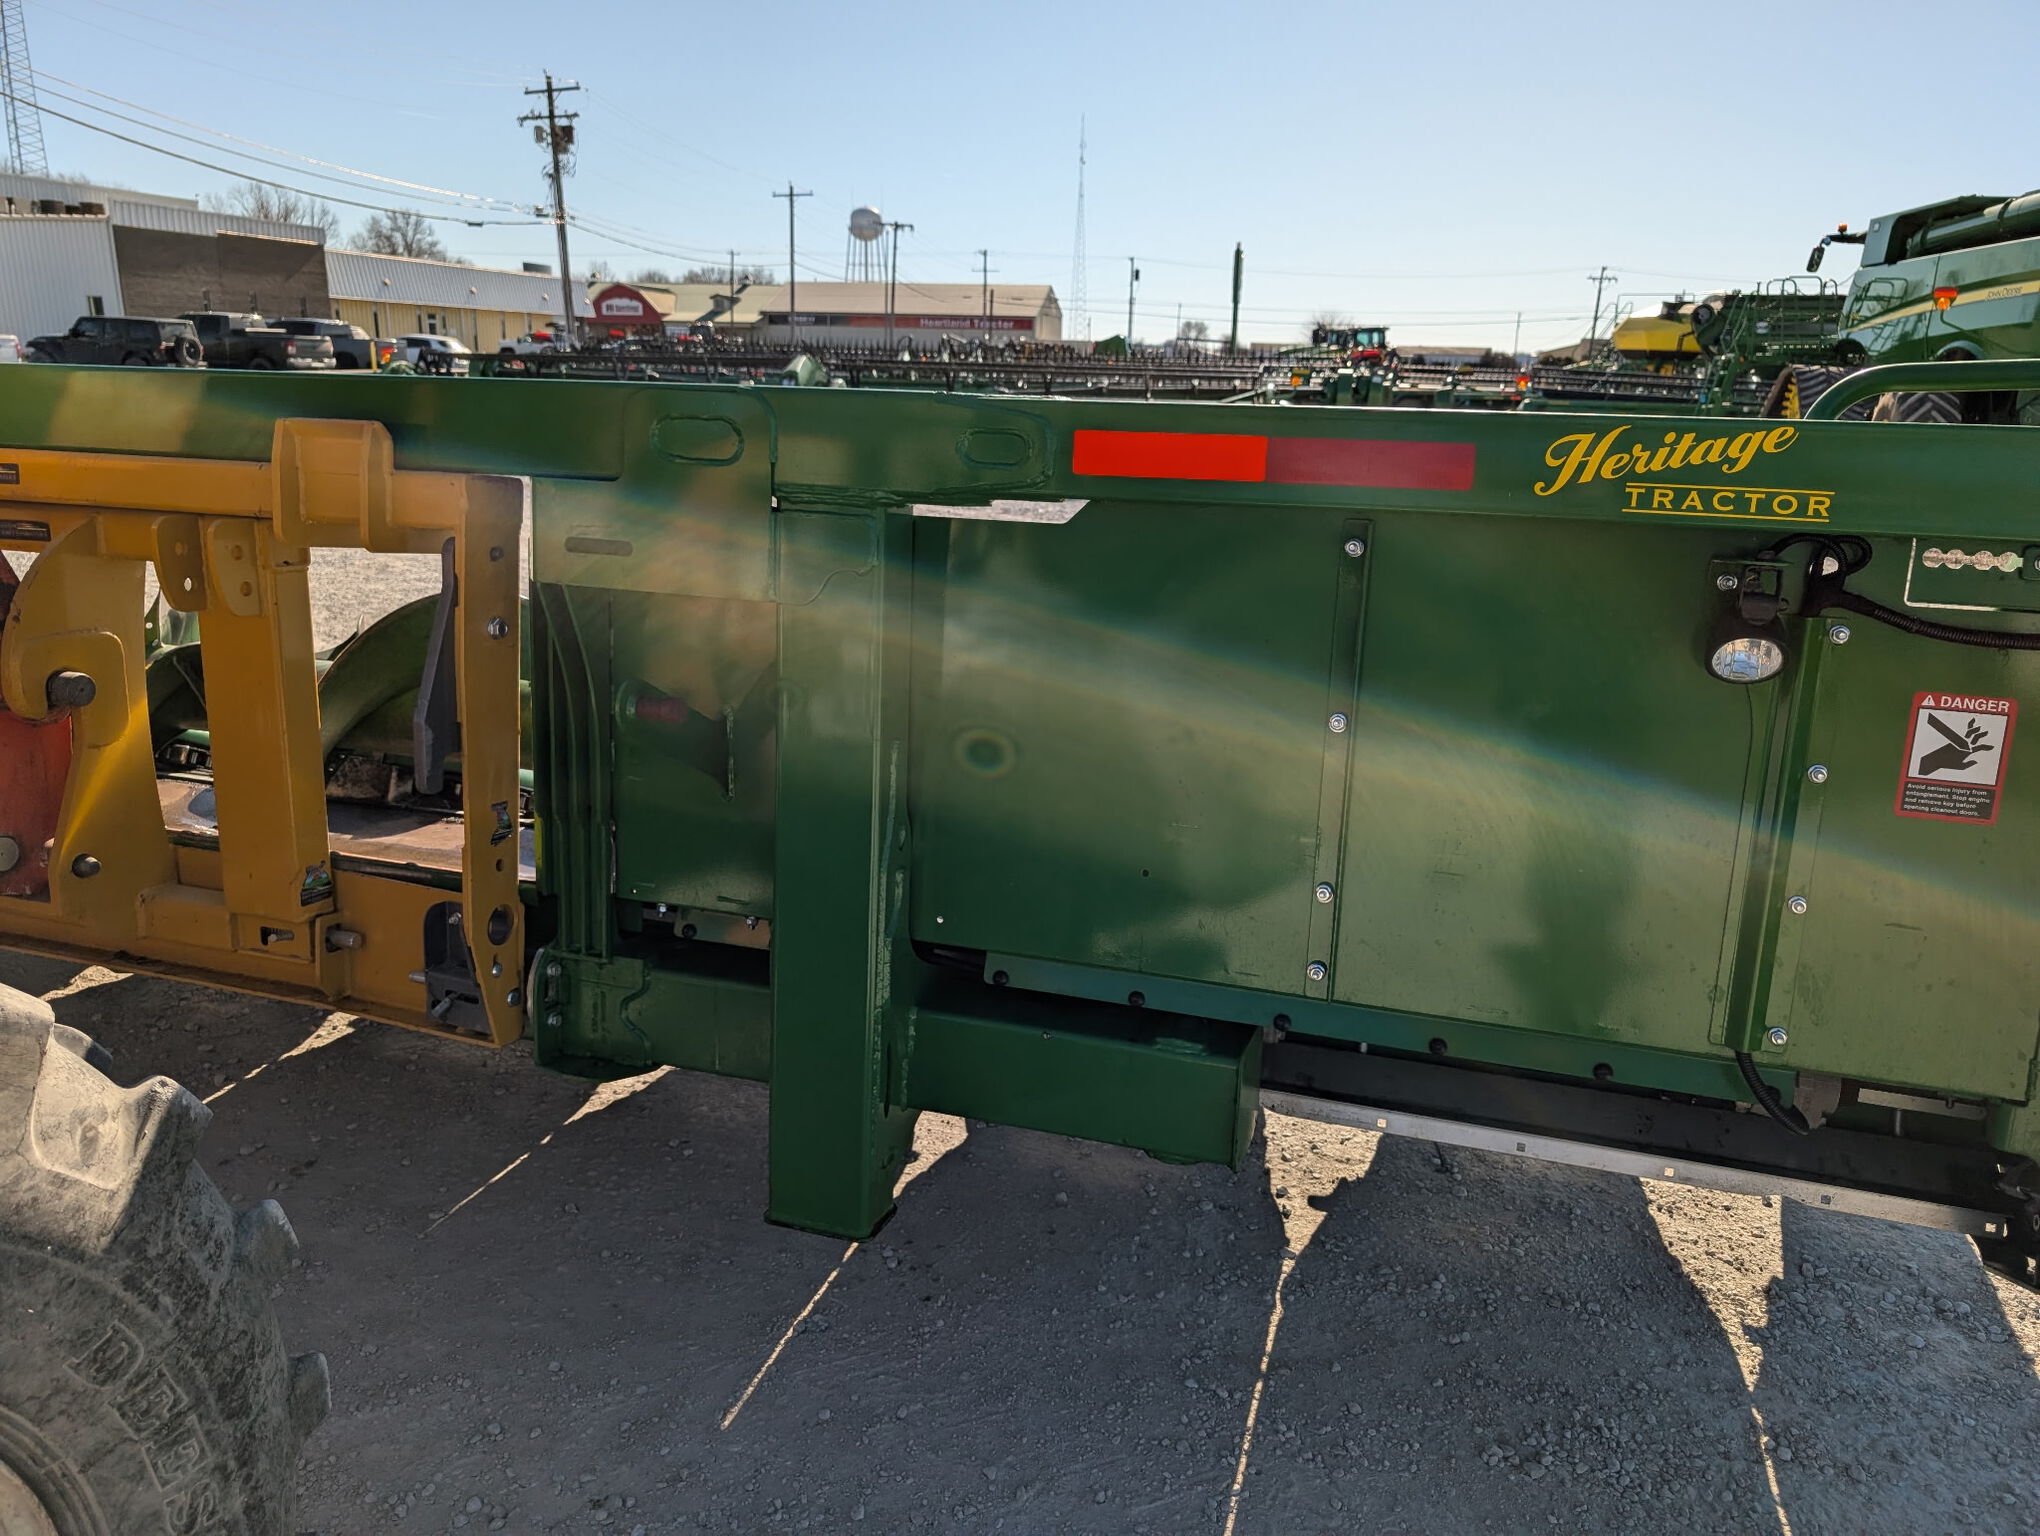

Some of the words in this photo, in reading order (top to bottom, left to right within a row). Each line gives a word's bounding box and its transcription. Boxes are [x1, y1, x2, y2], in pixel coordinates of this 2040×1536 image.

[1534, 425, 1799, 496] Heritage
[1625, 487, 1831, 517] TRACTOR
[1940, 697, 2010, 712] DANGER
[1952, 787, 1970, 795] injury
